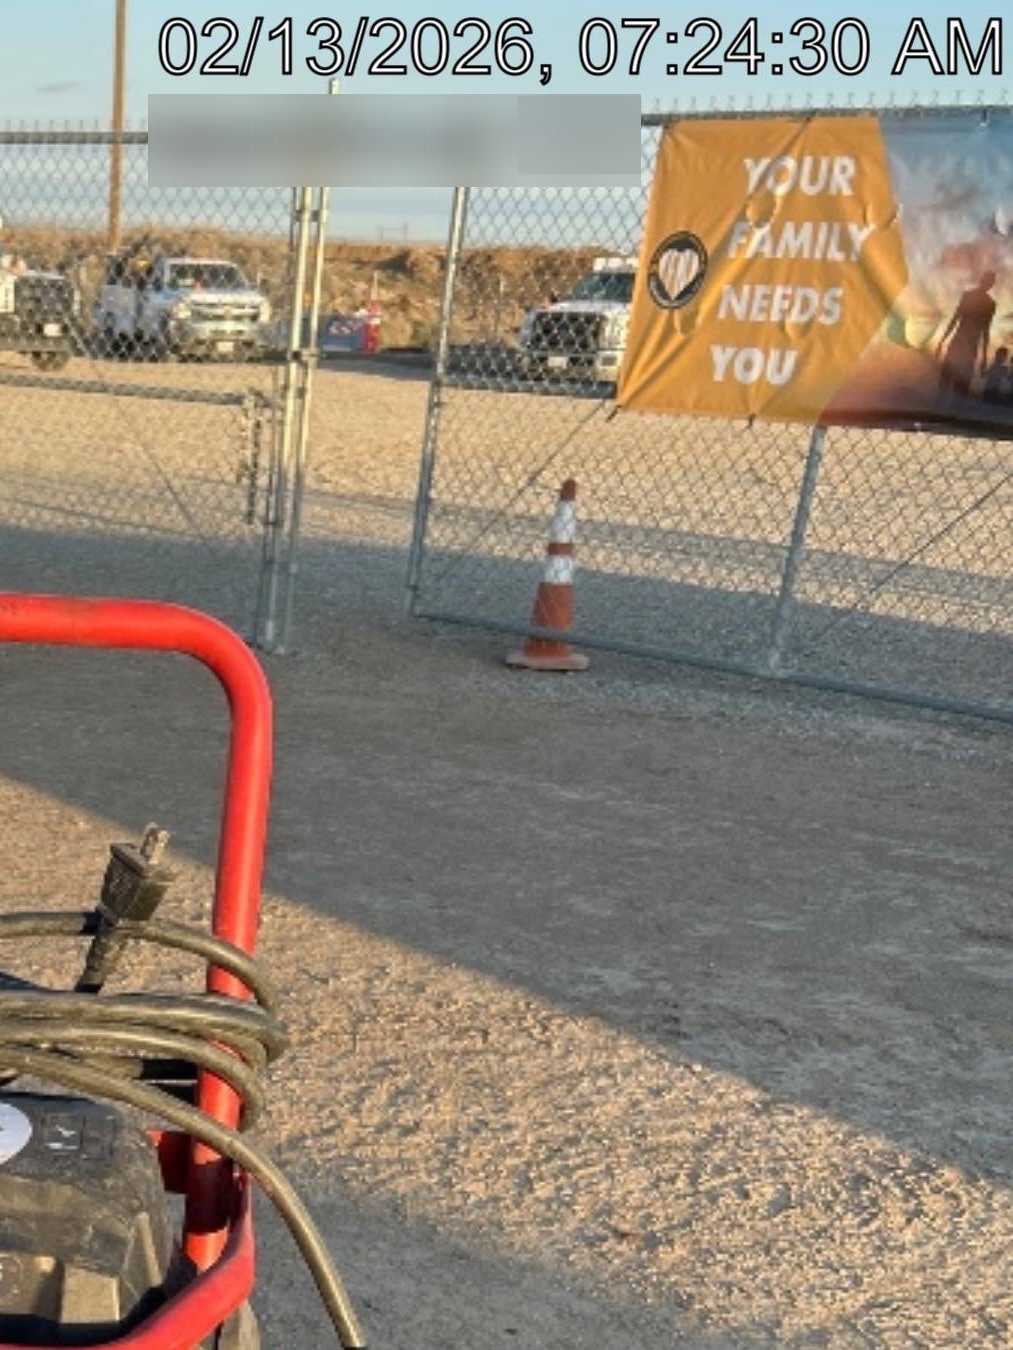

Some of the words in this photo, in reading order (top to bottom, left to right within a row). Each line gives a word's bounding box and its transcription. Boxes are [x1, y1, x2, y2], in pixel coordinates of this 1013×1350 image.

[744, 155, 856, 196] YOUR
[728, 221, 876, 262] FAMILY
[718, 284, 844, 326] NEEDS
[709, 344, 798, 385] YOU
